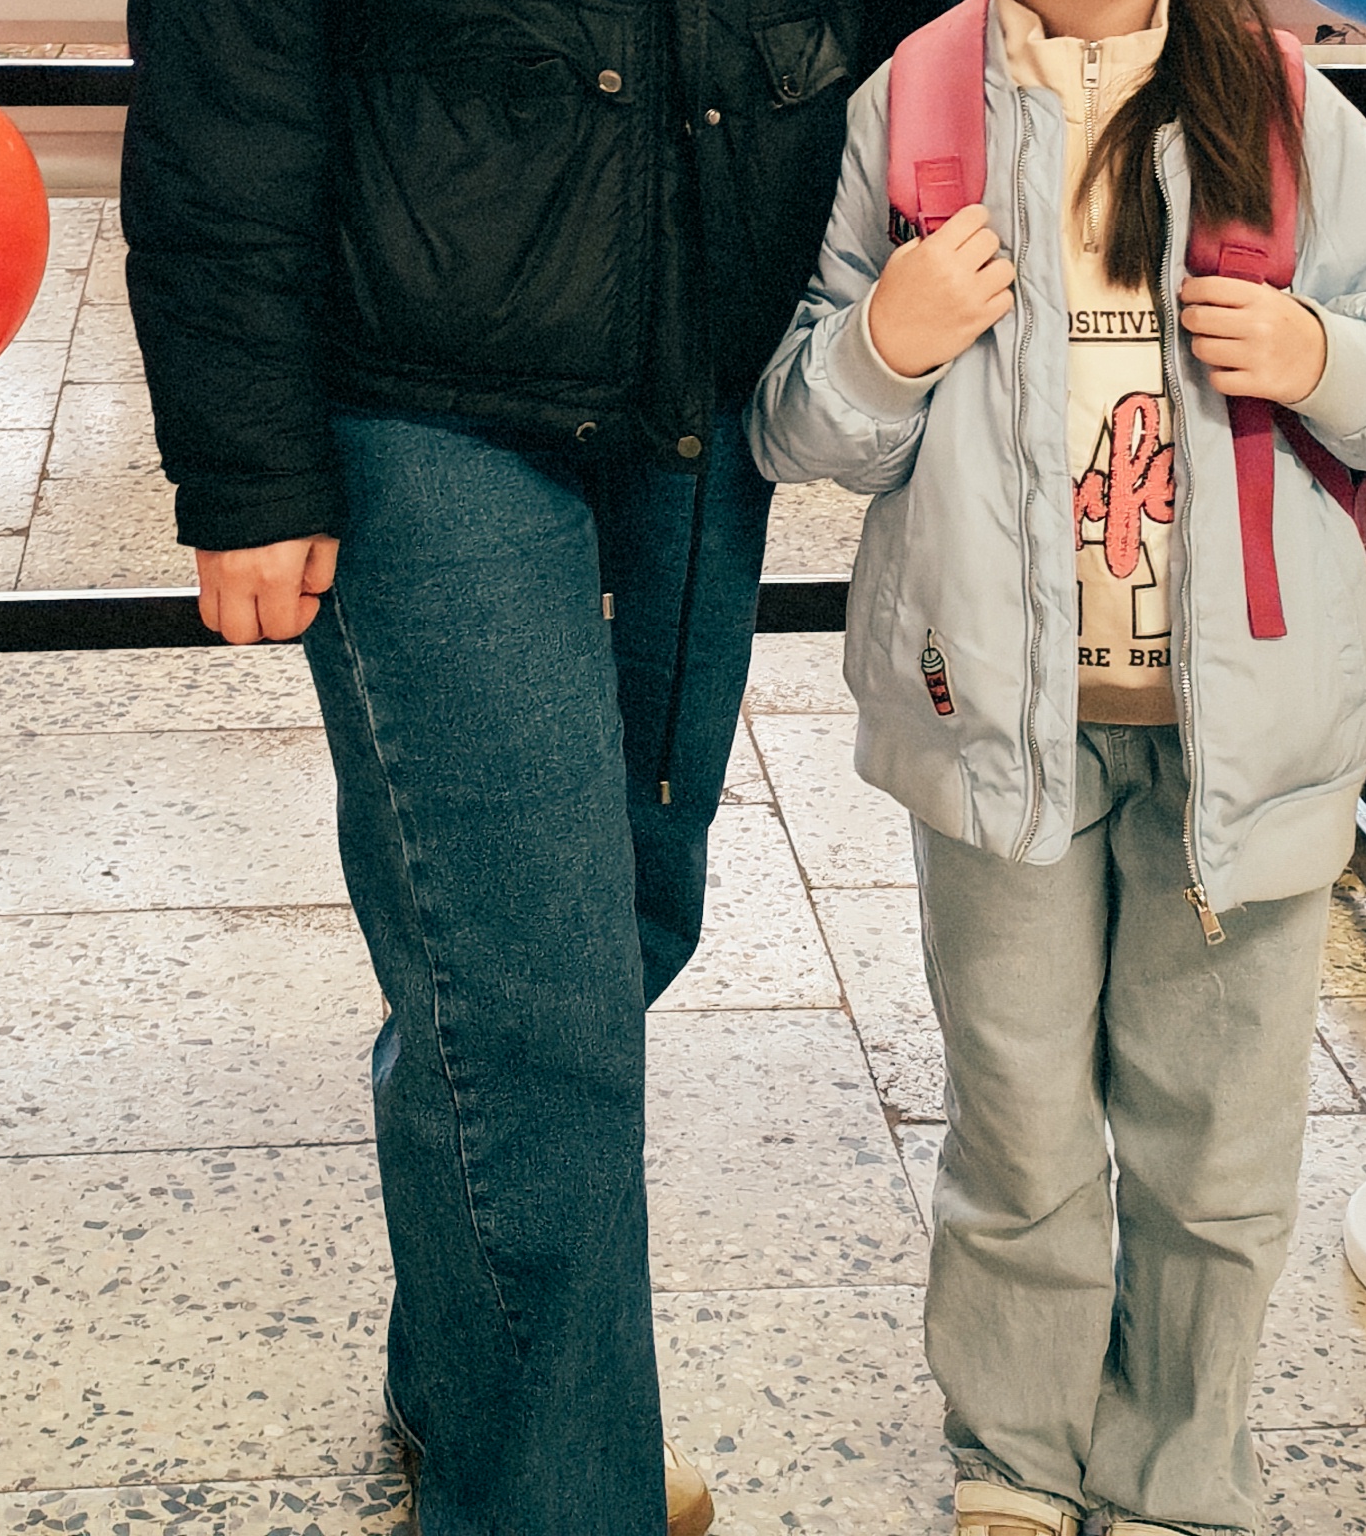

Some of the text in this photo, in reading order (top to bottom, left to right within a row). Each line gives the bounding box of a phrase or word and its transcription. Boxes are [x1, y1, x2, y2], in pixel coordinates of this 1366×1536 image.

[1069, 311, 1159, 334] SITIVE
[1078, 648, 1171, 667] RE BRI
